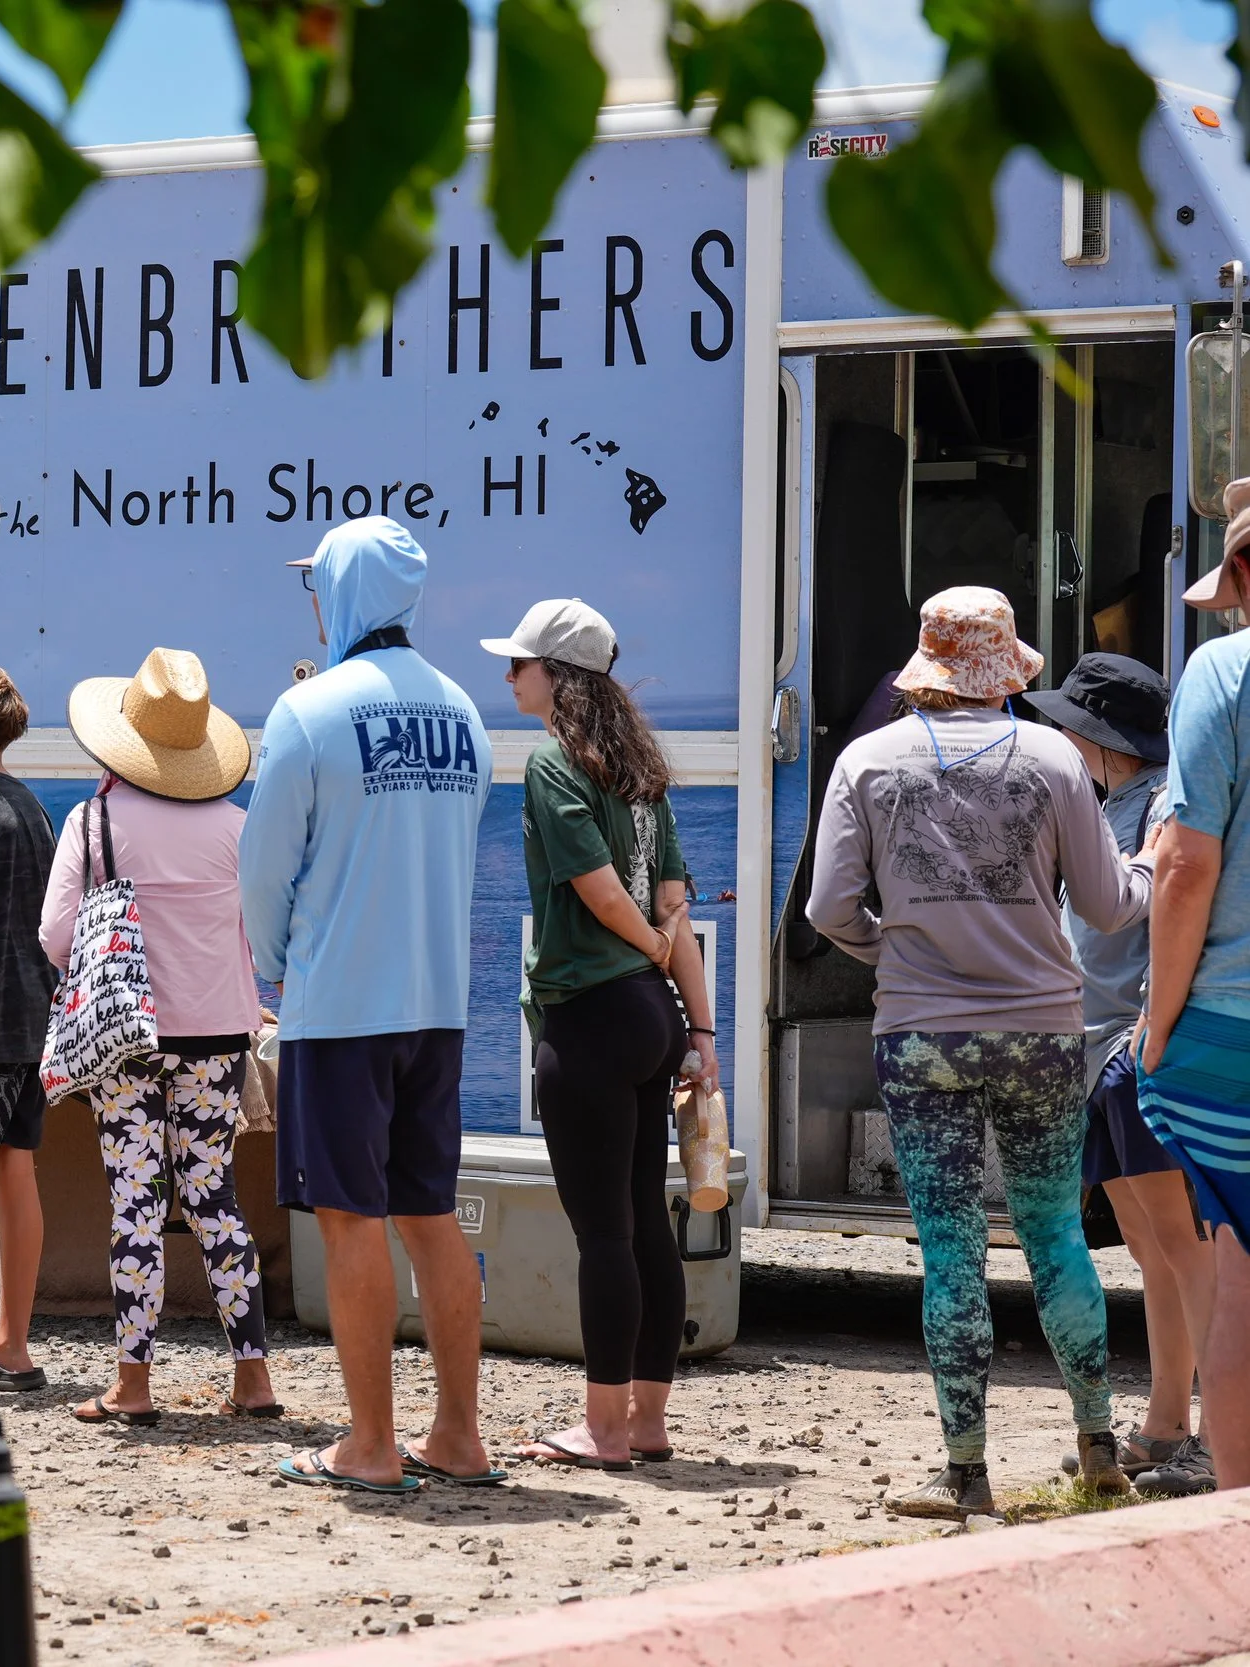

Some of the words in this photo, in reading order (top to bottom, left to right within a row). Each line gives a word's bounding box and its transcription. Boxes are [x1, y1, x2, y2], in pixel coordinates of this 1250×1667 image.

[72, 461, 236, 528] North
[266, 458, 450, 529] Shore,
[483, 454, 547, 518] HI
[406, 701, 436, 709] SCHOOLS
[364, 785, 380, 796] 50
[380, 782, 411, 793] YEARS
[413, 781, 424, 791] OF
[994, 896, 1037, 906] CONFERENCE
[94, 953, 130, 970] another
[91, 984, 126, 1006] another
[91, 1019, 124, 1042] another
[67, 1041, 113, 1081] kekahi
